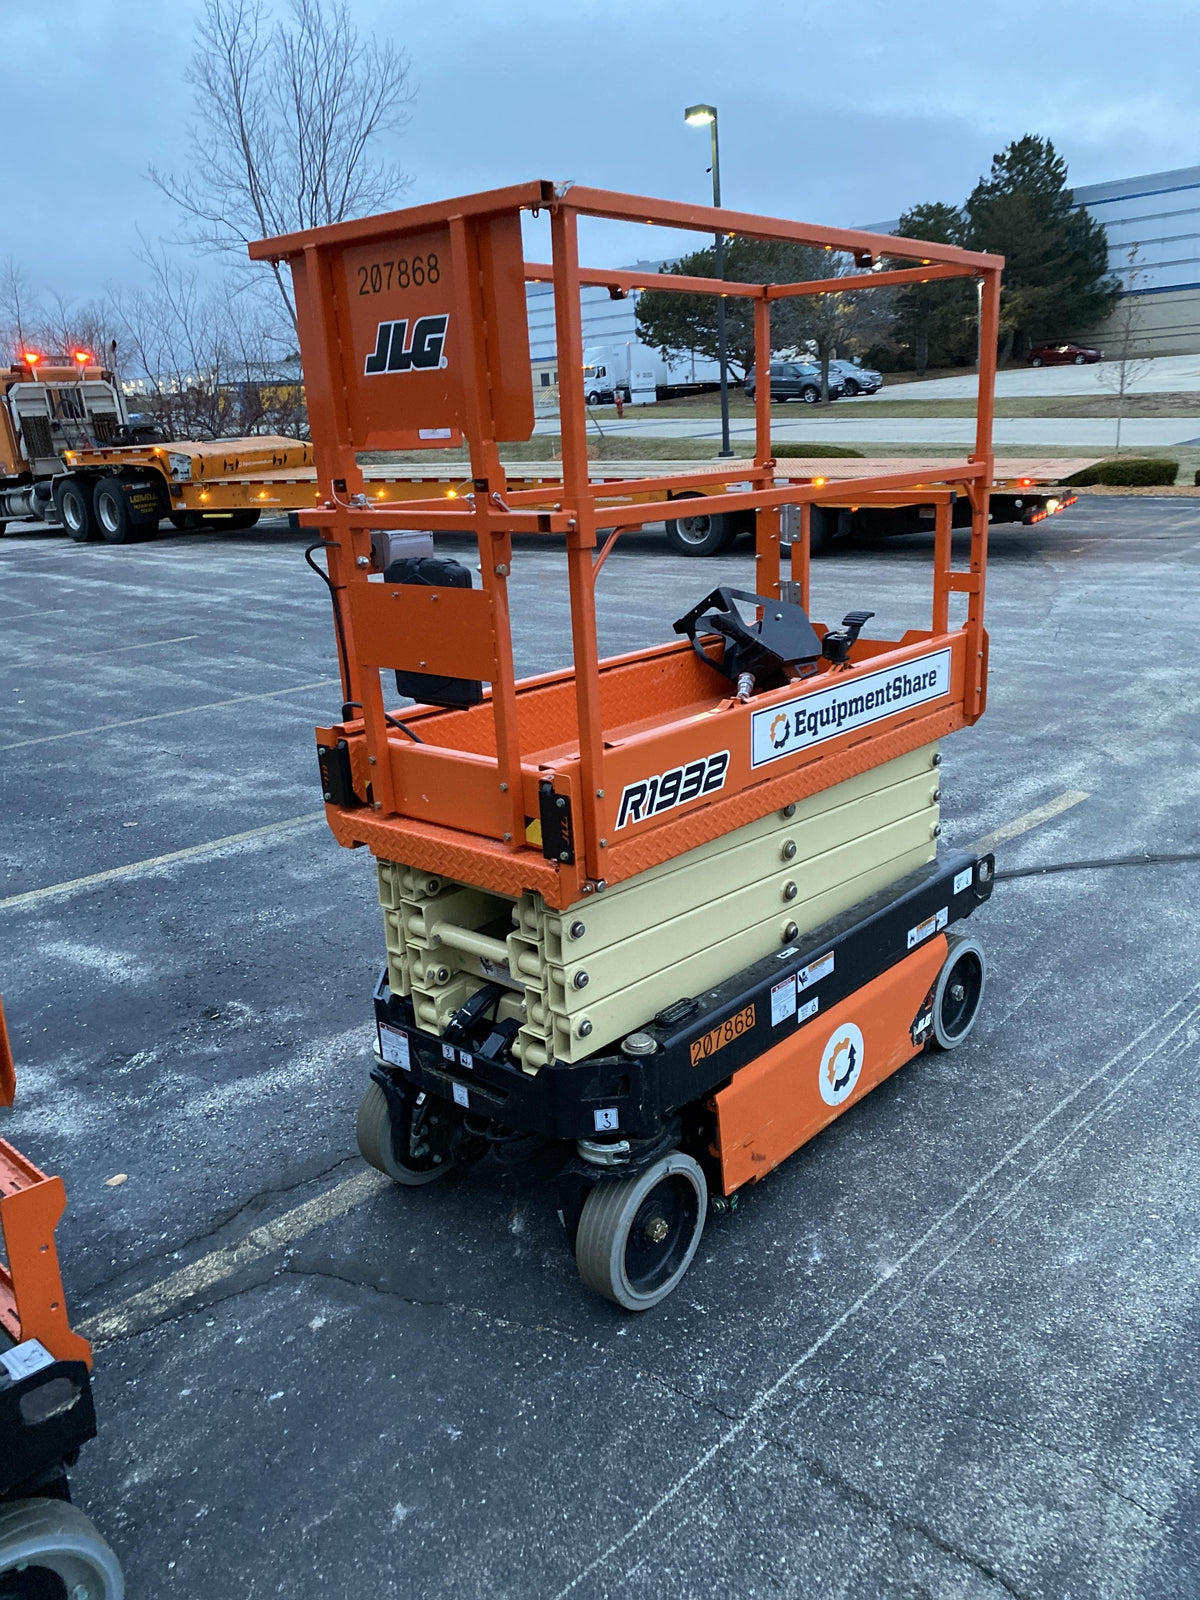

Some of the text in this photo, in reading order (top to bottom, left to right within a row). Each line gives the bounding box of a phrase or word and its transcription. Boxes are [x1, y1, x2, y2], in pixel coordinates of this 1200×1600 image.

[357, 253, 440, 296] 207868
[364, 313, 450, 376] JLG
[793, 669, 937, 737] EquipmentShare
[614, 749, 731, 831] R1932
[692, 1006, 754, 1065] 207868
